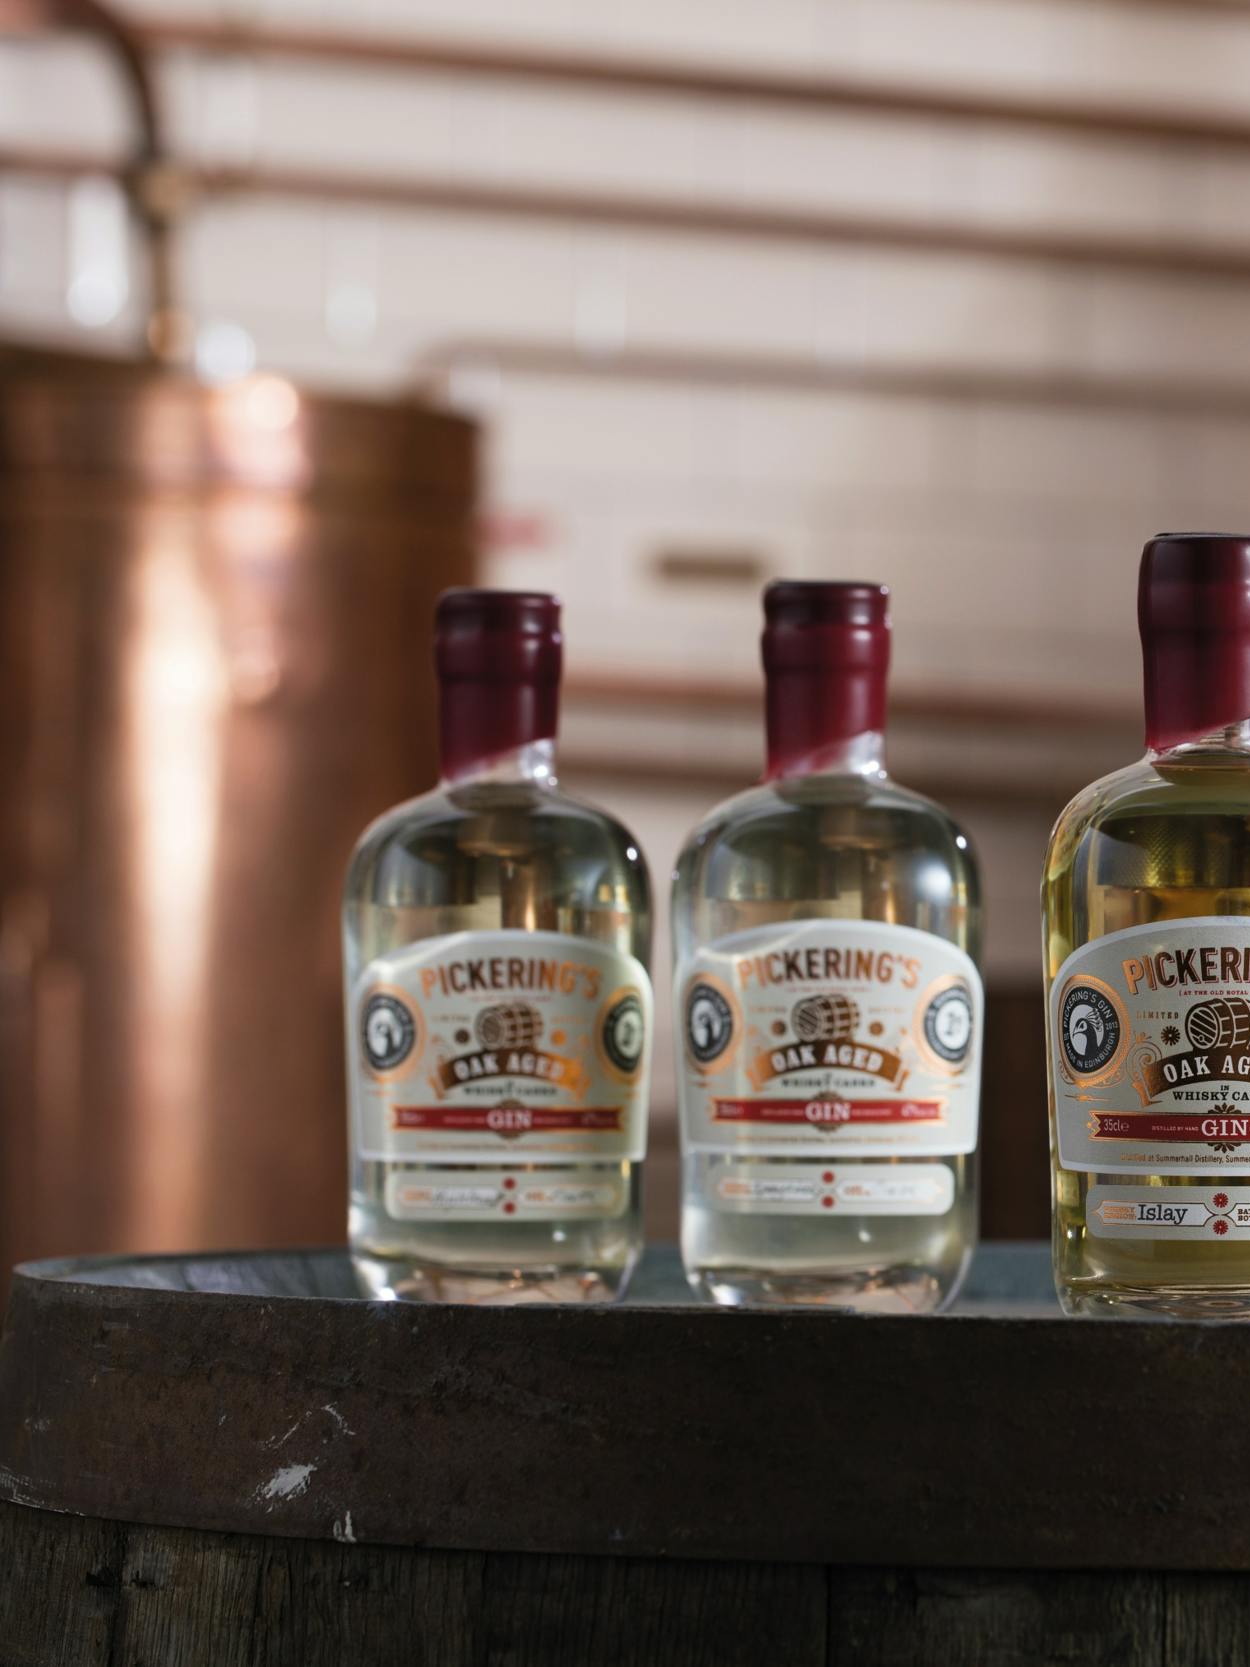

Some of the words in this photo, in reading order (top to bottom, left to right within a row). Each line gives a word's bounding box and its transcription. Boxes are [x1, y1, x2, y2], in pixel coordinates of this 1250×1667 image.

[418, 956, 601, 999] PICKERING'S
[737, 947, 922, 990] PICKERING'S
[1097, 1000, 1112, 1019] GIN
[453, 1052, 499, 1079] OAK
[506, 1052, 566, 1079] AGED
[771, 1046, 815, 1073] OAK
[823, 1044, 883, 1073] AGED
[1163, 1056, 1211, 1082] OAK
[1173, 1091, 1229, 1101] WHISKY
[487, 1109, 532, 1130] GIN
[805, 1102, 851, 1122] GIN
[1201, 1119, 1249, 1136] GIN
[1137, 1204, 1188, 1225] Islay
